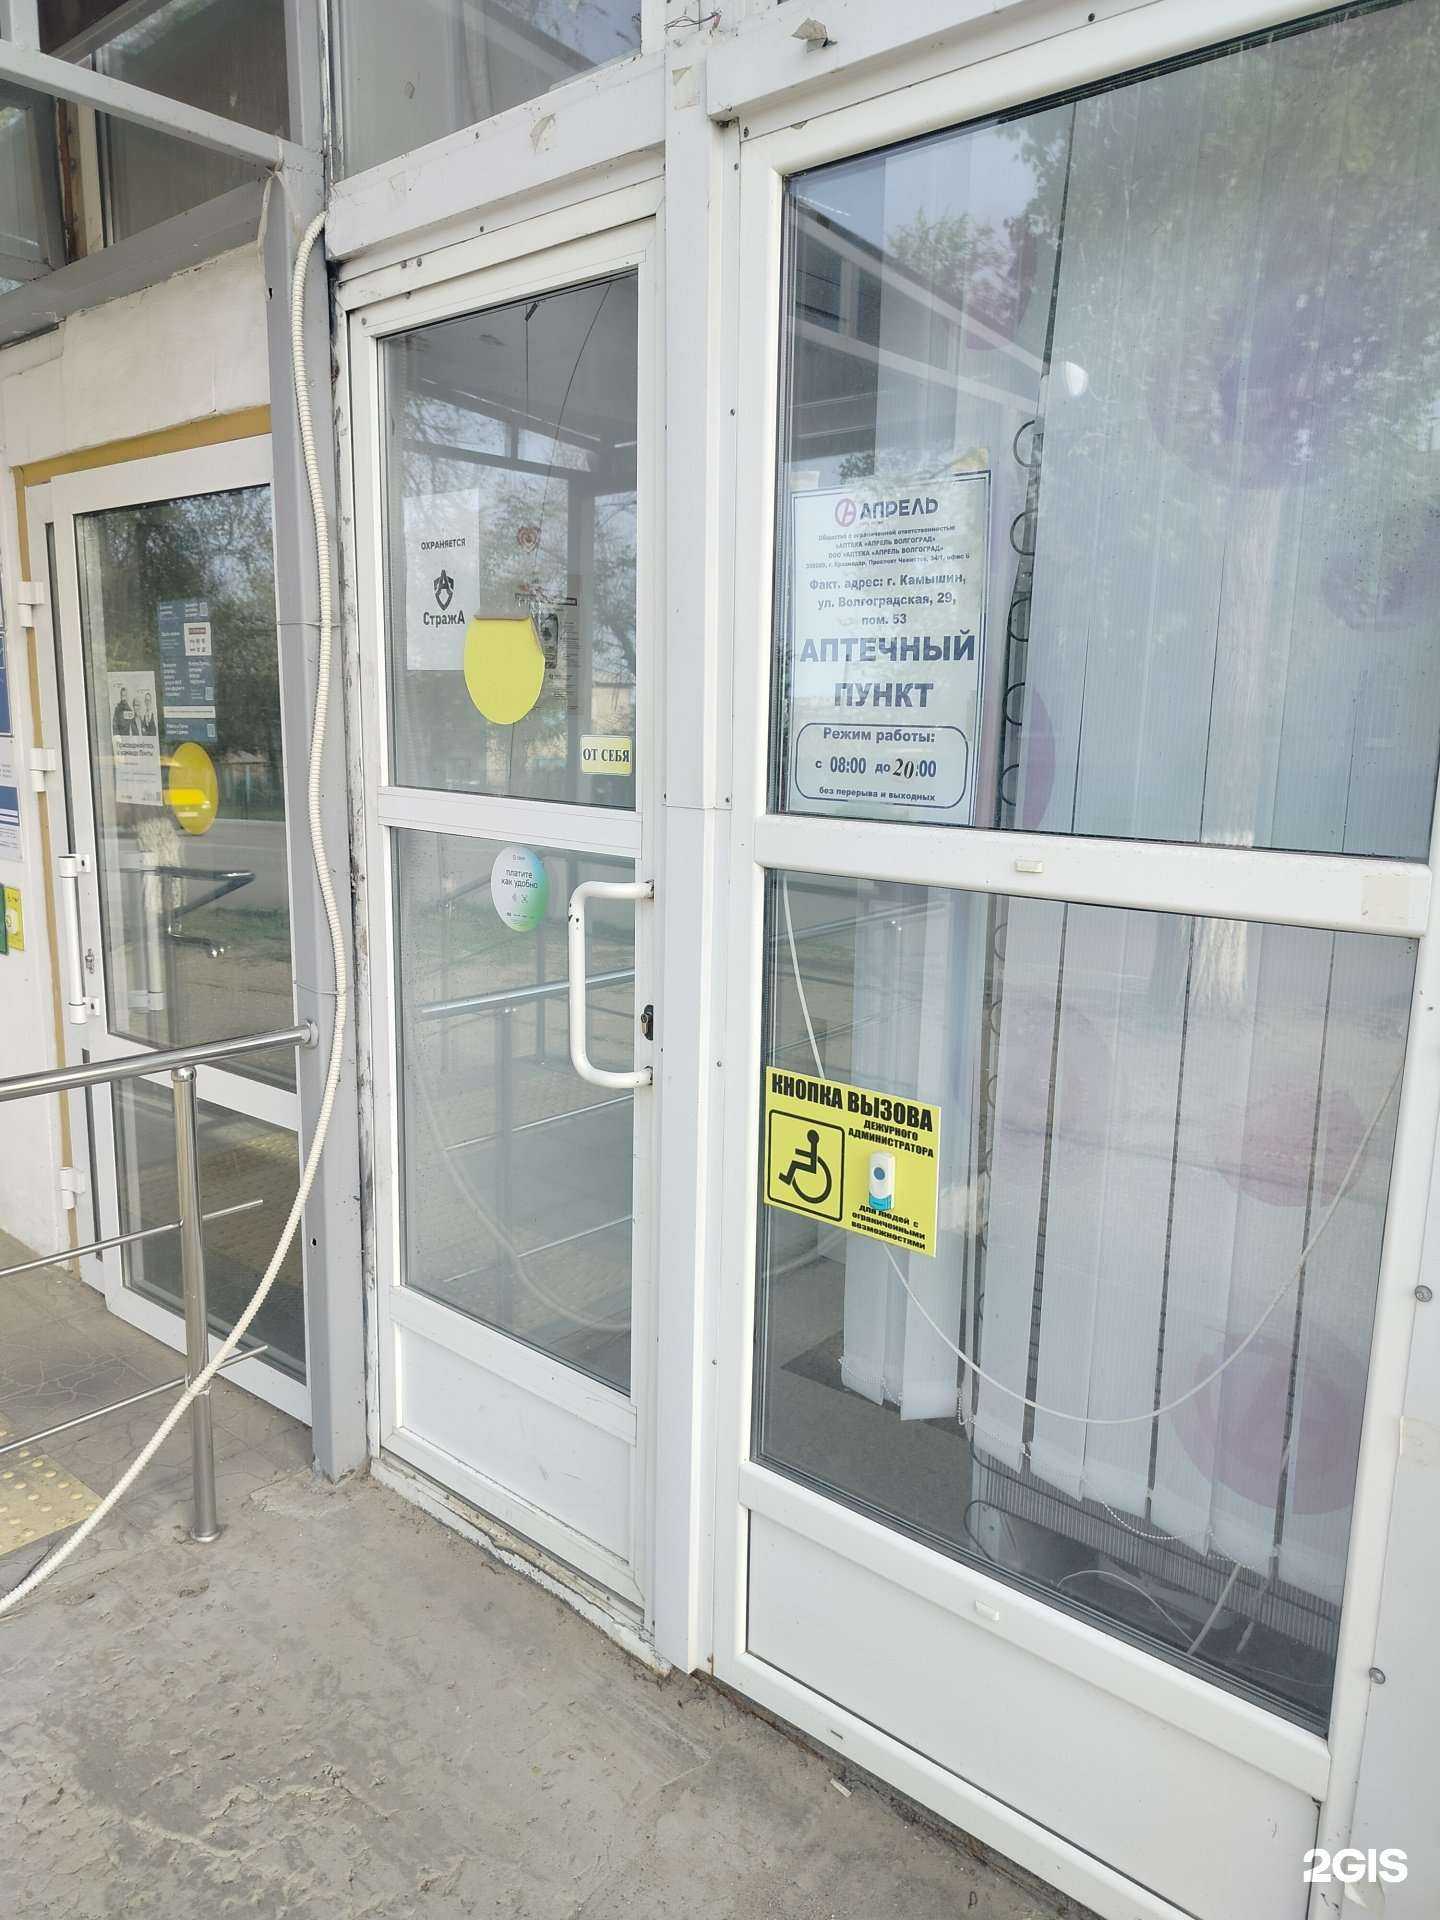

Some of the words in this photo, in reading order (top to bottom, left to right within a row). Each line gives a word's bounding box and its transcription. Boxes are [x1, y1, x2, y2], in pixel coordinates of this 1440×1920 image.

[859, 497, 939, 520] АПРЕЛЬ
[898, 525, 956, 535] ответственностью
[420, 538, 466, 551] ОХРАНЯЕТСЯ
[809, 579, 841, 590] Факт.
[844, 578, 884, 591] адрес:
[886, 577, 897, 587] г.
[899, 573, 967, 587] Камышин,
[817, 599, 835, 609] ул.
[837, 594, 934, 608] Волгоградская,
[936, 592, 957, 606] 29,
[423, 610, 466, 627] СтражА
[861, 615, 889, 626] пом.
[892, 613, 907, 625] 53
[799, 628, 976, 663] АПТЕЧНЫЙ
[834, 682, 934, 708] ПУНКТ
[823, 726, 872, 741] Режим
[875, 729, 936, 744] работы:
[582, 745, 599, 762] ОТ
[600, 746, 631, 764] СЕБЯ
[815, 760, 823, 769] с
[829, 756, 867, 775] 08:00
[874, 762, 891, 774] до
[818, 786, 834, 796] без
[835, 789, 879, 800] перерыва
[888, 792, 936, 802] выходных
[505, 869, 533, 879] платите
[513, 879, 539, 889] удобно
[772, 1072, 844, 1110] КНОПКА
[847, 1090, 934, 1132] ВЫЗОВА
[863, 1119, 919, 1142] ДЕЖУРНОГО
[848, 1127, 935, 1158] АДМИНИСТРАТОРА
[851, 1211, 926, 1240] ограниченными
[878, 1210, 911, 1225] людей
[851, 1221, 927, 1250] возможностями
